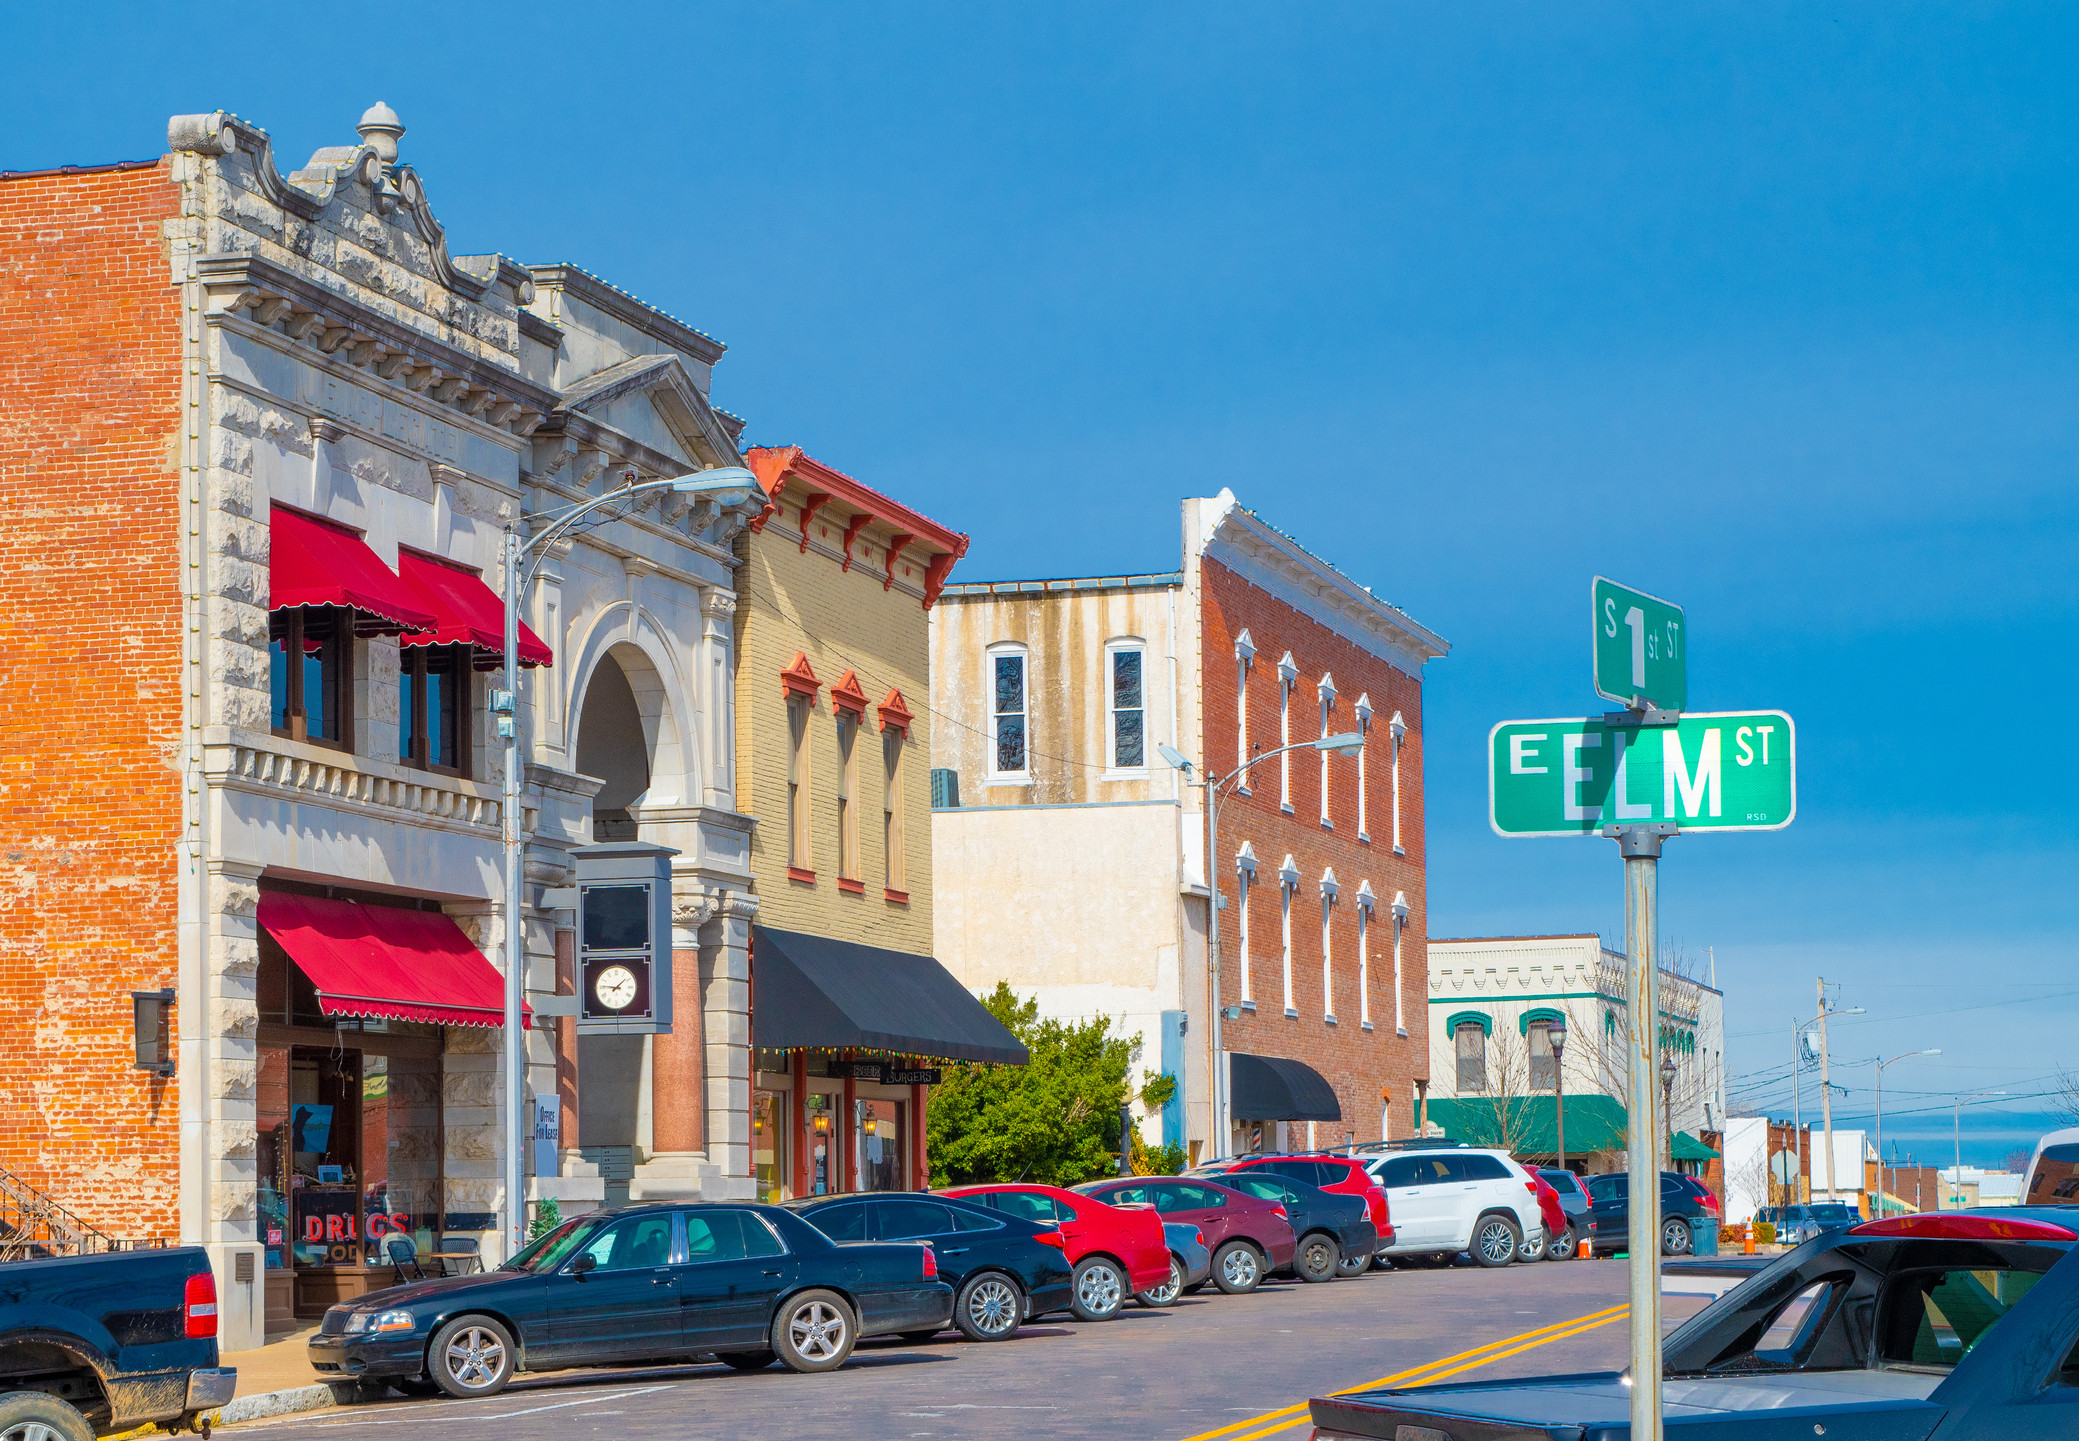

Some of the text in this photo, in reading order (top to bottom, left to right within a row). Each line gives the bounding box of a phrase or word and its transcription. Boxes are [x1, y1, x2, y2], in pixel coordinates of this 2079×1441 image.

[1605, 598, 1679, 689] S 1st ST
[1510, 726, 1774, 821] E ELM ST
[1746, 813, 1767, 821] RSD
[853, 1064, 881, 1077] BEER
